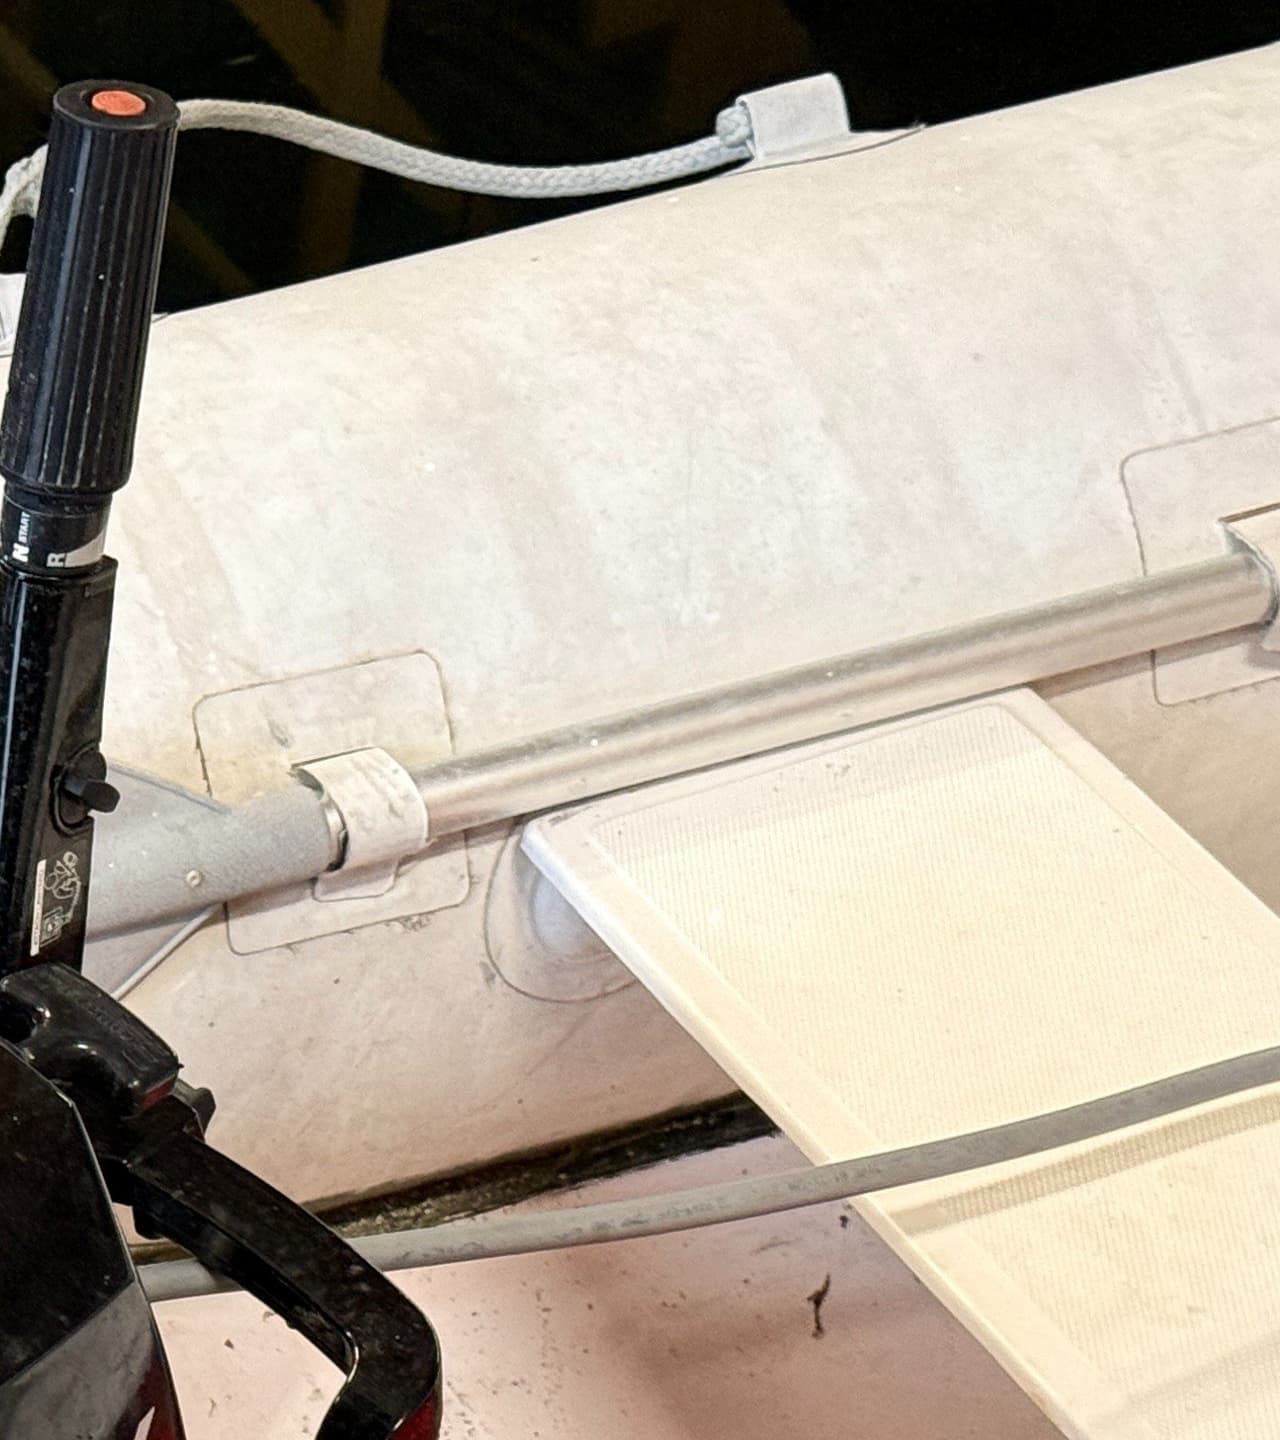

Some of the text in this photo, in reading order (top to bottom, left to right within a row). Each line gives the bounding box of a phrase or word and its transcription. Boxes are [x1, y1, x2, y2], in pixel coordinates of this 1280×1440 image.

[12, 511, 30, 563] N START
[46, 552, 66, 567] R
